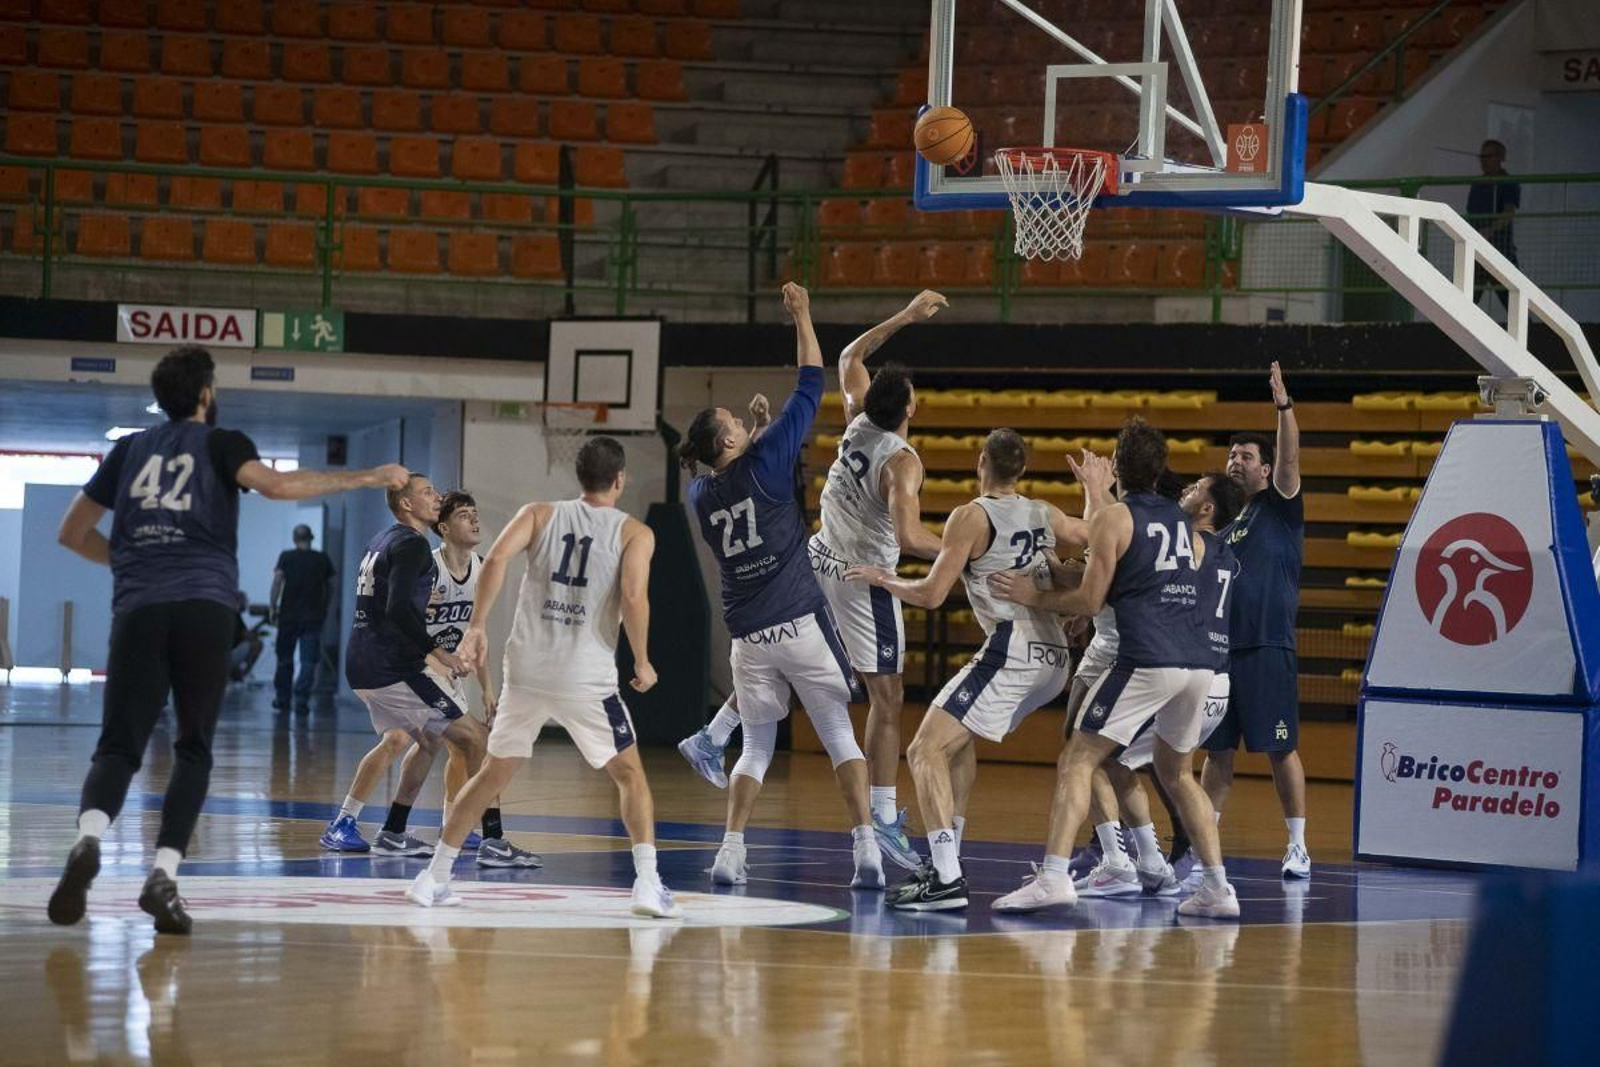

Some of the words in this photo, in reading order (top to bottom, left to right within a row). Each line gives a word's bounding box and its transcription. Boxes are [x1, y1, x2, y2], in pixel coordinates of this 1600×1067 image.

[131, 311, 243, 341] SAIDA
[129, 453, 194, 511] 42
[710, 497, 764, 558] 27
[551, 533, 594, 588] 11
[1147, 521, 1197, 571] 24
[735, 555, 777, 574] ABANCA
[1161, 584, 1197, 596] ABANCA
[1216, 569, 1231, 618] 7
[543, 599, 586, 616] ABANCA
[1396, 755, 1559, 789] BricoCentro
[1431, 786, 1560, 818] Paradelo
